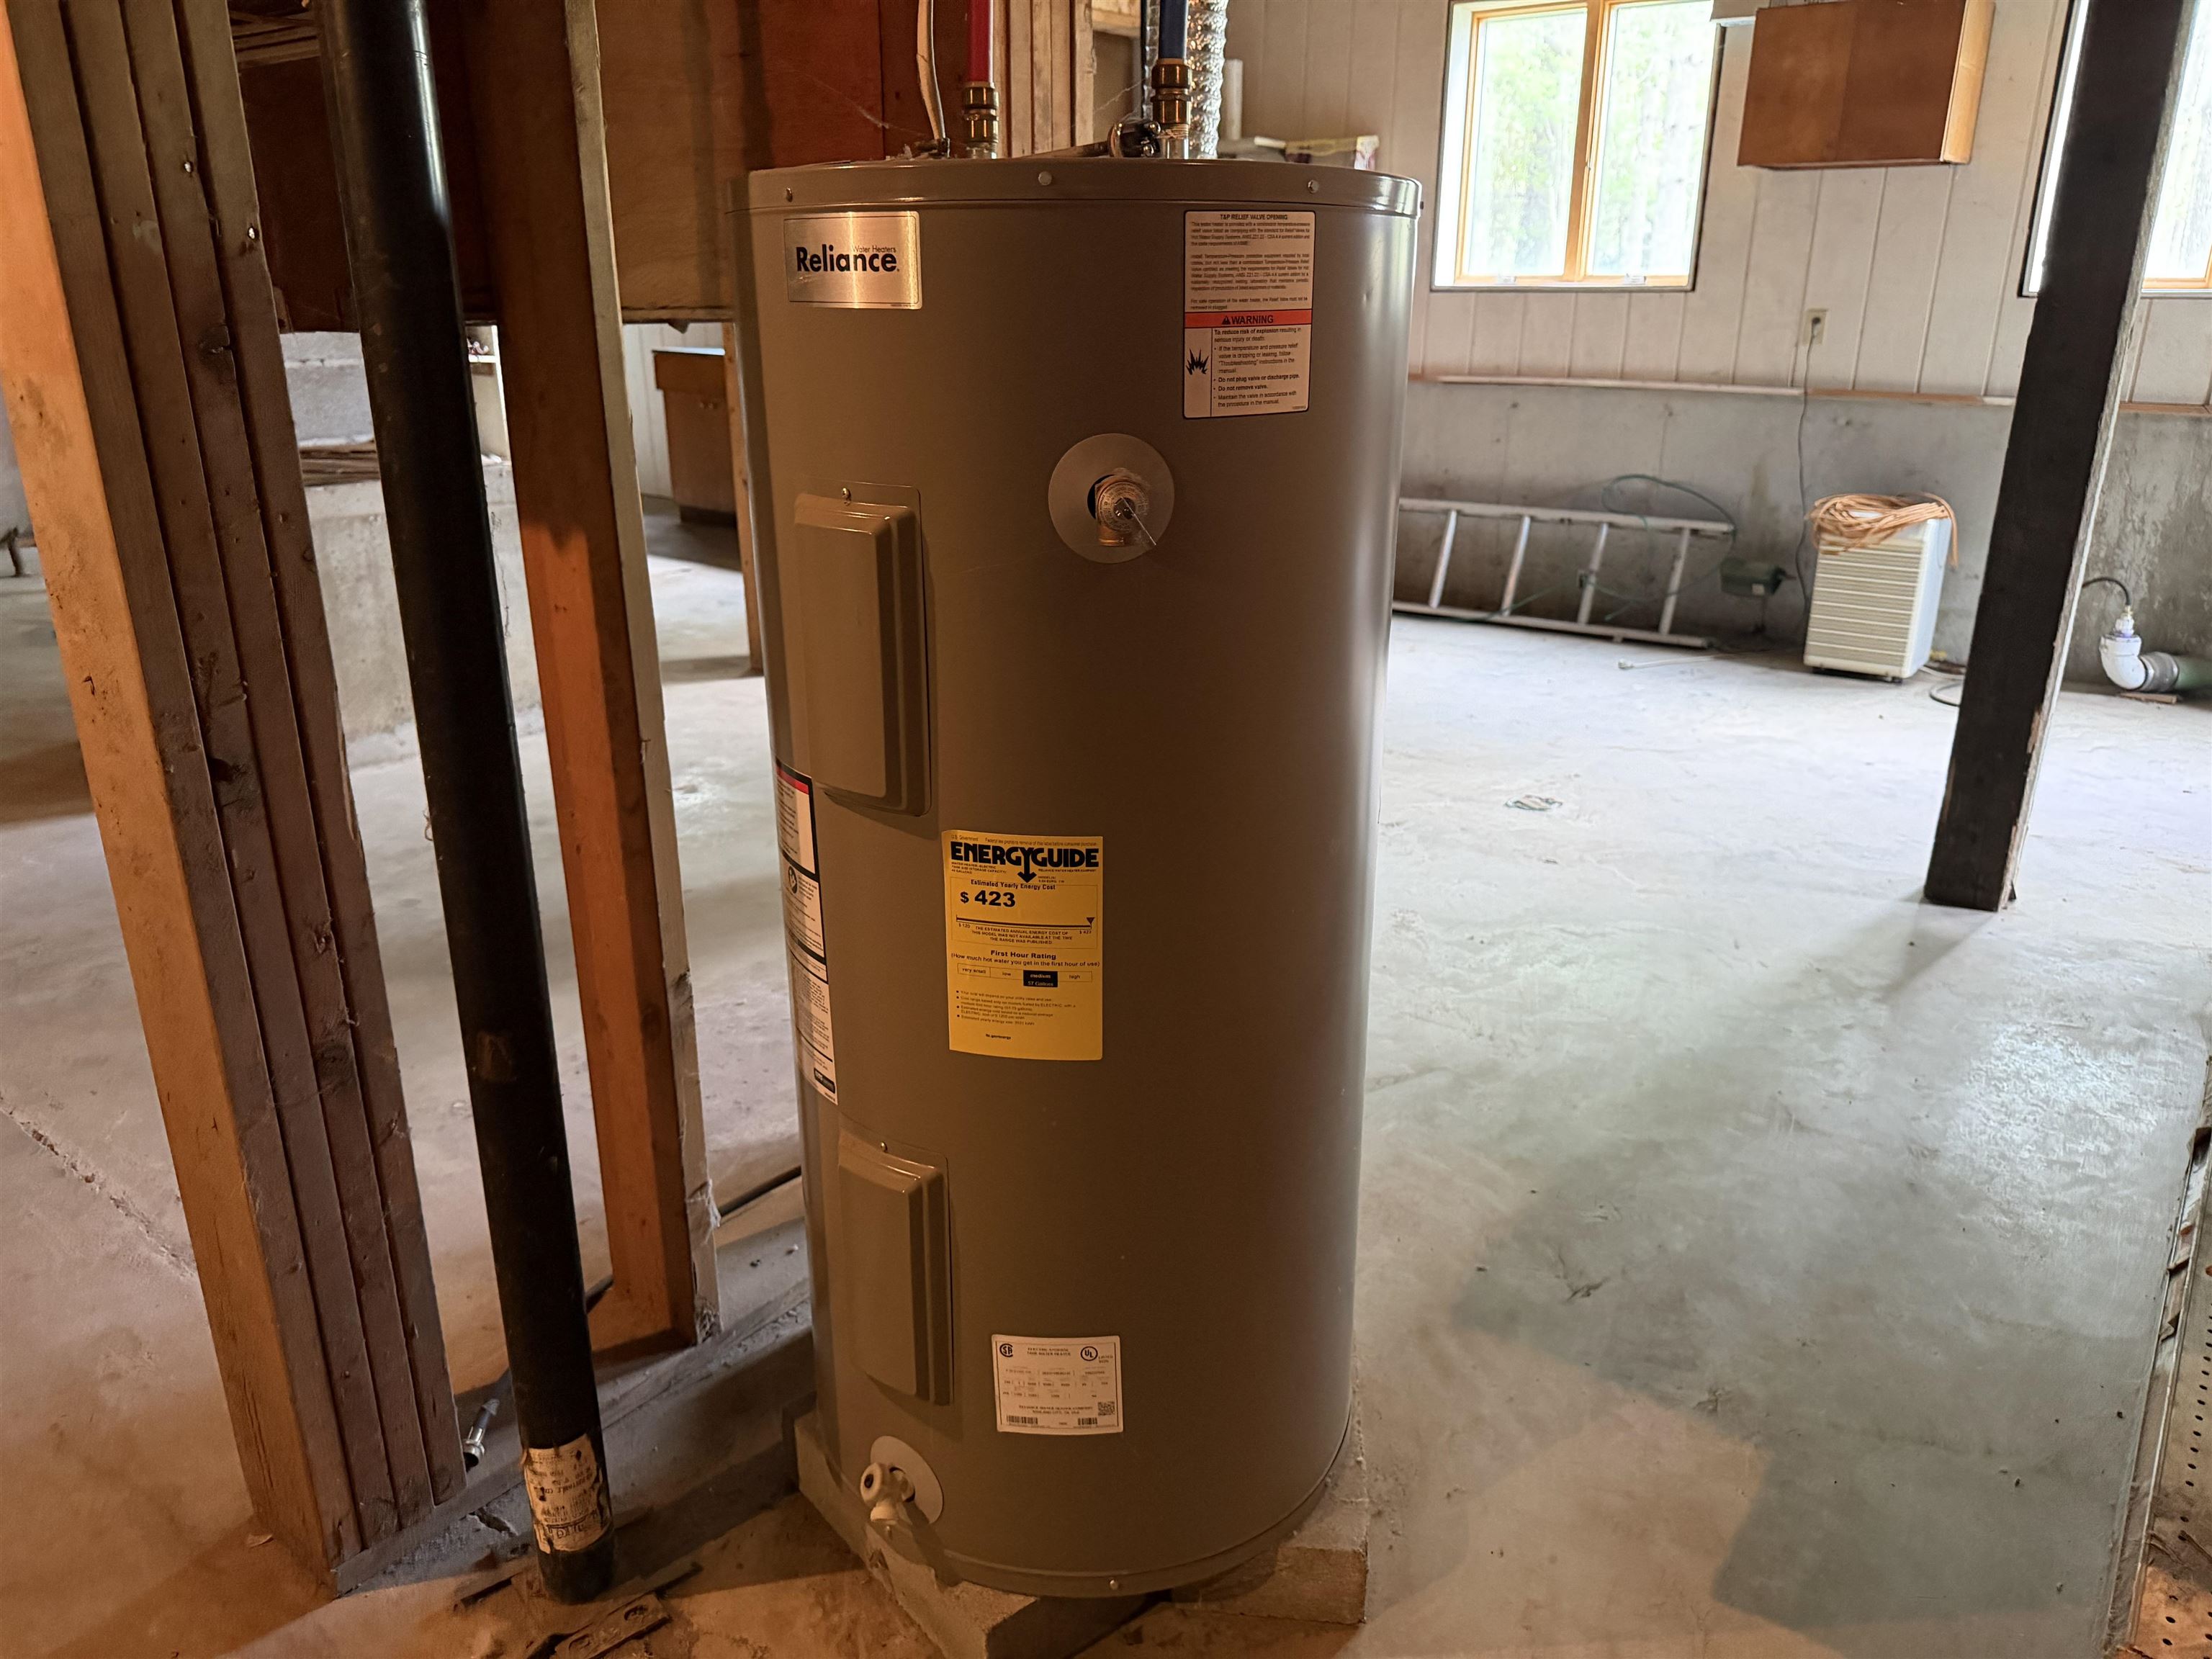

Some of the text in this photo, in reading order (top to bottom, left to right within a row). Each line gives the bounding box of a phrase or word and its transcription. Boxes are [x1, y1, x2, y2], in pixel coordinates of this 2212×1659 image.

[796, 243, 898, 272] Reliance
[1231, 315, 1274, 325] WARNING
[950, 841, 1099, 868] ENERGYGUIDE
[971, 879, 998, 887] Estimated
[960, 890, 1016, 907] $ 423
